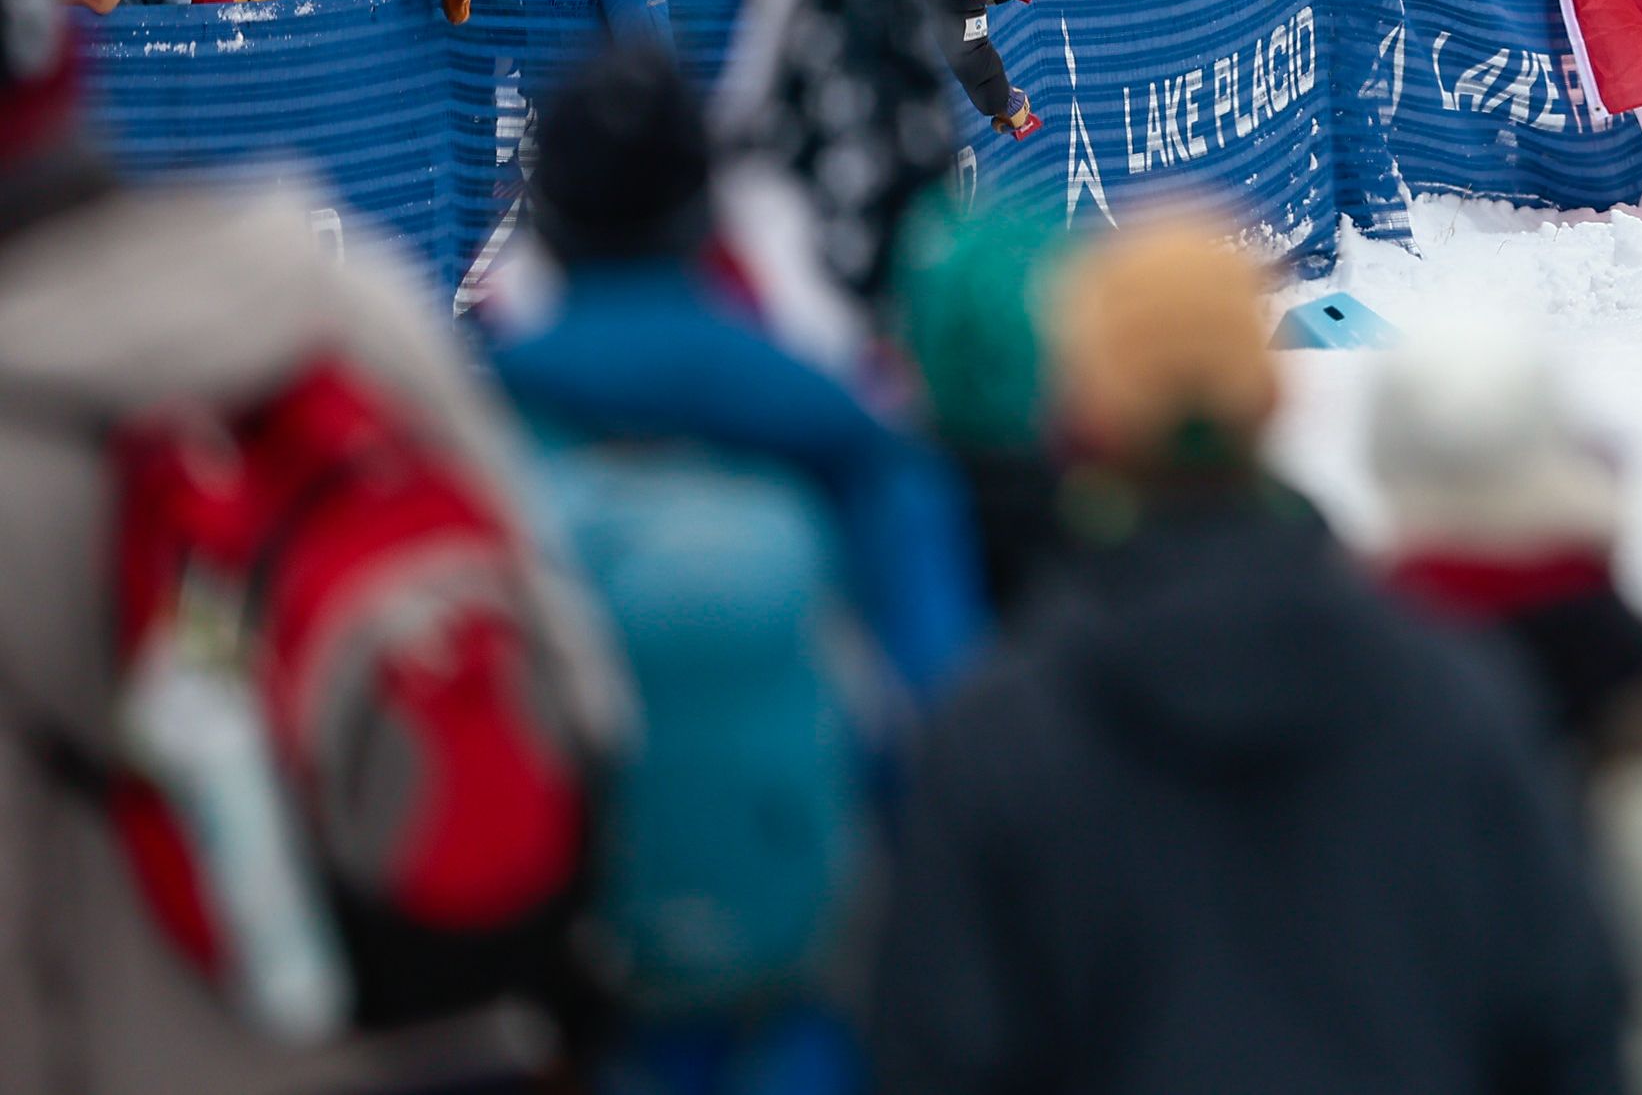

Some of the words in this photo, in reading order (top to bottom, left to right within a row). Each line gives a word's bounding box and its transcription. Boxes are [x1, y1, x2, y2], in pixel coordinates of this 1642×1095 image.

[1123, 69, 1209, 174] LAKE
[1213, 6, 1316, 148] PLACID
[1432, 31, 1566, 133] LAKE
